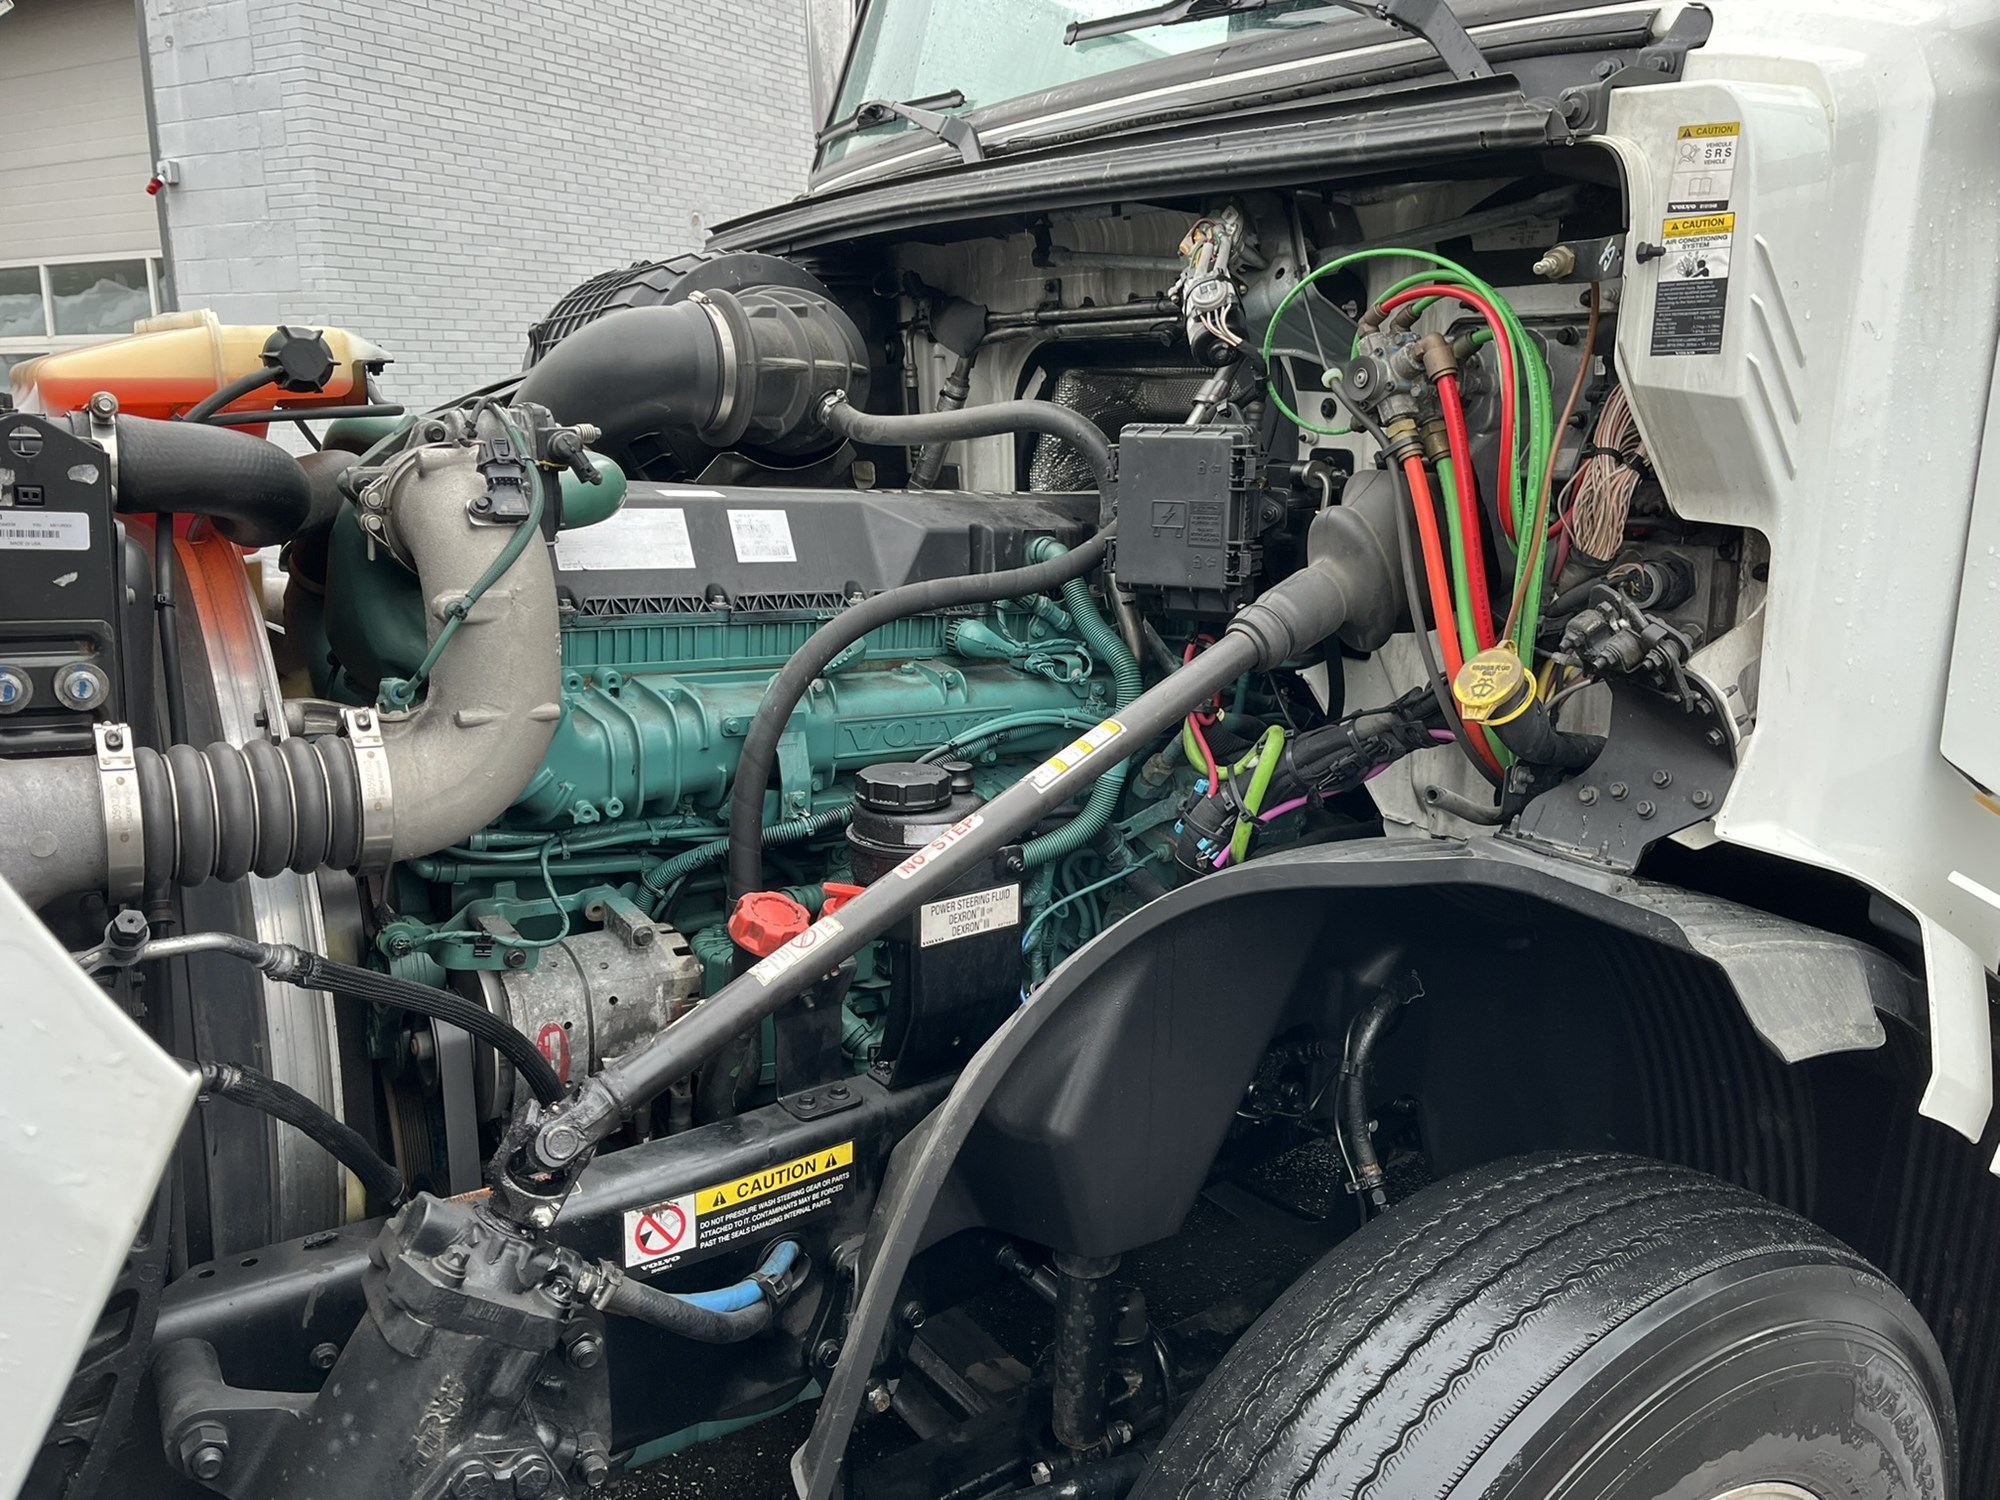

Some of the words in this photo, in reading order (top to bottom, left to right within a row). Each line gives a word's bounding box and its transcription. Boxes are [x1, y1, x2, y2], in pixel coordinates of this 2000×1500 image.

[1696, 125, 1733, 136] CAUTION
[1682, 217, 1725, 230] CAUTION
[1665, 238, 1677, 246] AIR
[1677, 233, 1728, 245] CONDITIONING
[1682, 241, 1710, 250] SYSTEM
[899, 855, 926, 874] NO
[931, 817, 975, 851] STEP
[931, 901, 956, 917] POWER
[957, 893, 990, 910] STEERING
[991, 888, 1011, 903] FLUID
[737, 1158, 816, 1198] CAUTION
[700, 1220, 710, 1230] DO
[711, 1216, 724, 1226] NOT
[725, 1204, 757, 1221] PRESSURE
[758, 1198, 776, 1210] WASH
[776, 1187, 805, 1204] STEERING
[805, 1181, 822, 1193] GEAR
[822, 1178, 831, 1187] OR
[831, 1171, 850, 1184] PARTS
[700, 1223, 734, 1239] ATTACHED
[734, 1219, 743, 1228] TO
[743, 1216, 751, 1225] IT.
[751, 1199, 798, 1222] CONTAMINANTS
[798, 1195, 812, 1205] MAY
[812, 1191, 820, 1201] BE
[820, 1183, 844, 1197] FORCED
[700, 1238, 717, 1249] PAST
[718, 1233, 731, 1243] THE
[731, 1226, 751, 1239] SEALS
[751, 1215, 783, 1232] DAMAGING
[783, 1205, 811, 1221] INTERNAL
[811, 1197, 832, 1210] PARTS.
[640, 1255, 681, 1271] VOLVO
